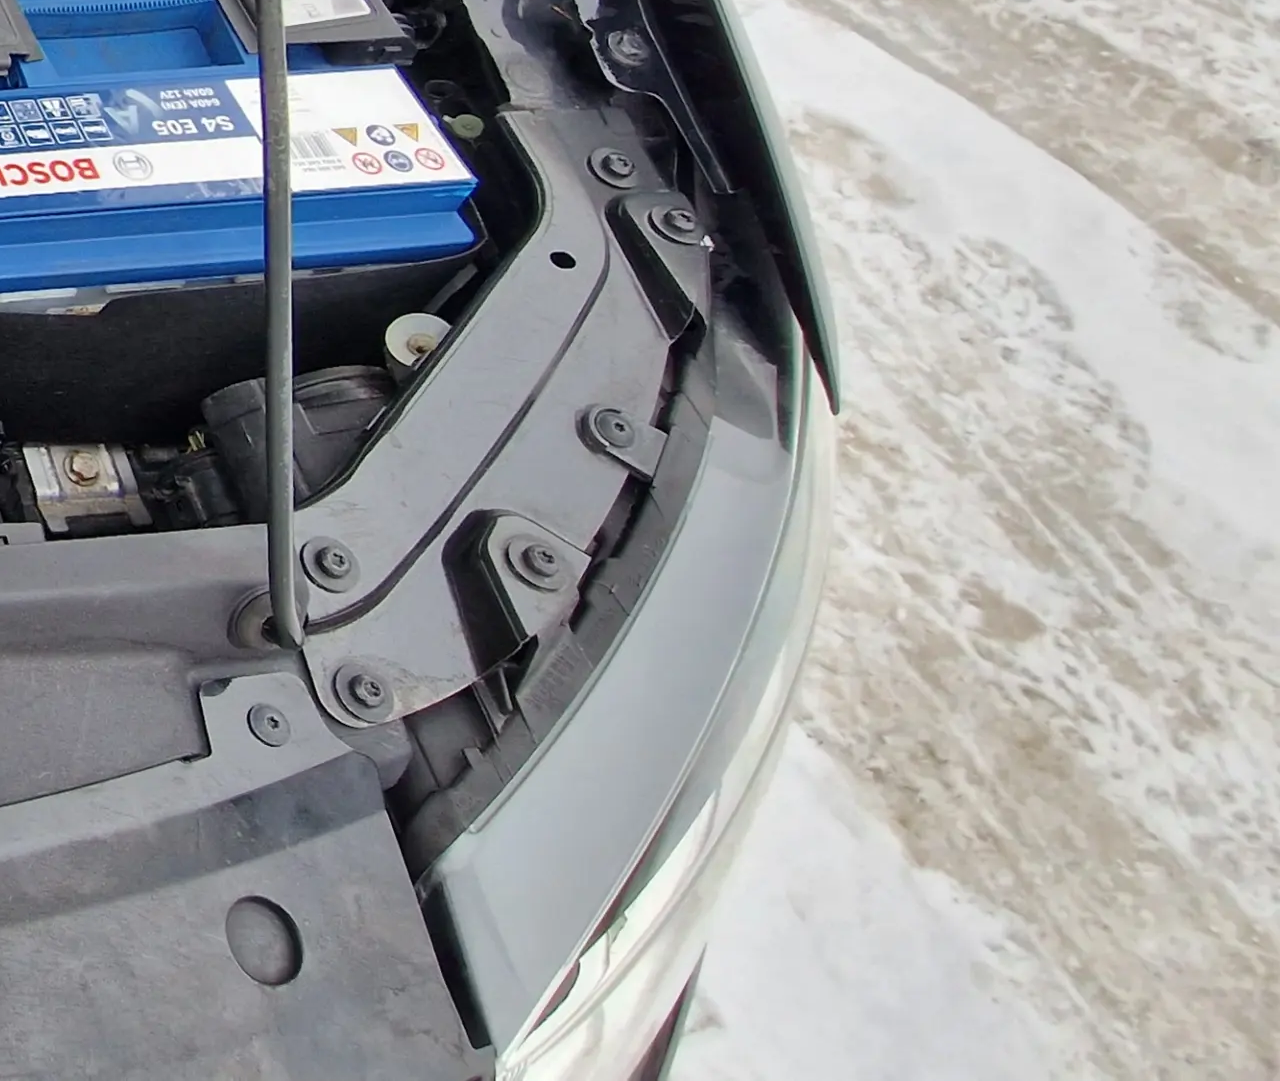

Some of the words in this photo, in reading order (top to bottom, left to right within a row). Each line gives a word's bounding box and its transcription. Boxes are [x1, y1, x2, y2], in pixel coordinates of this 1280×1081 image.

[160, 90, 181, 100] 12V
[161, 99, 188, 111] (EN)
[191, 98, 221, 108] 640A
[151, 117, 198, 136] E05
[201, 115, 235, 132] S4
